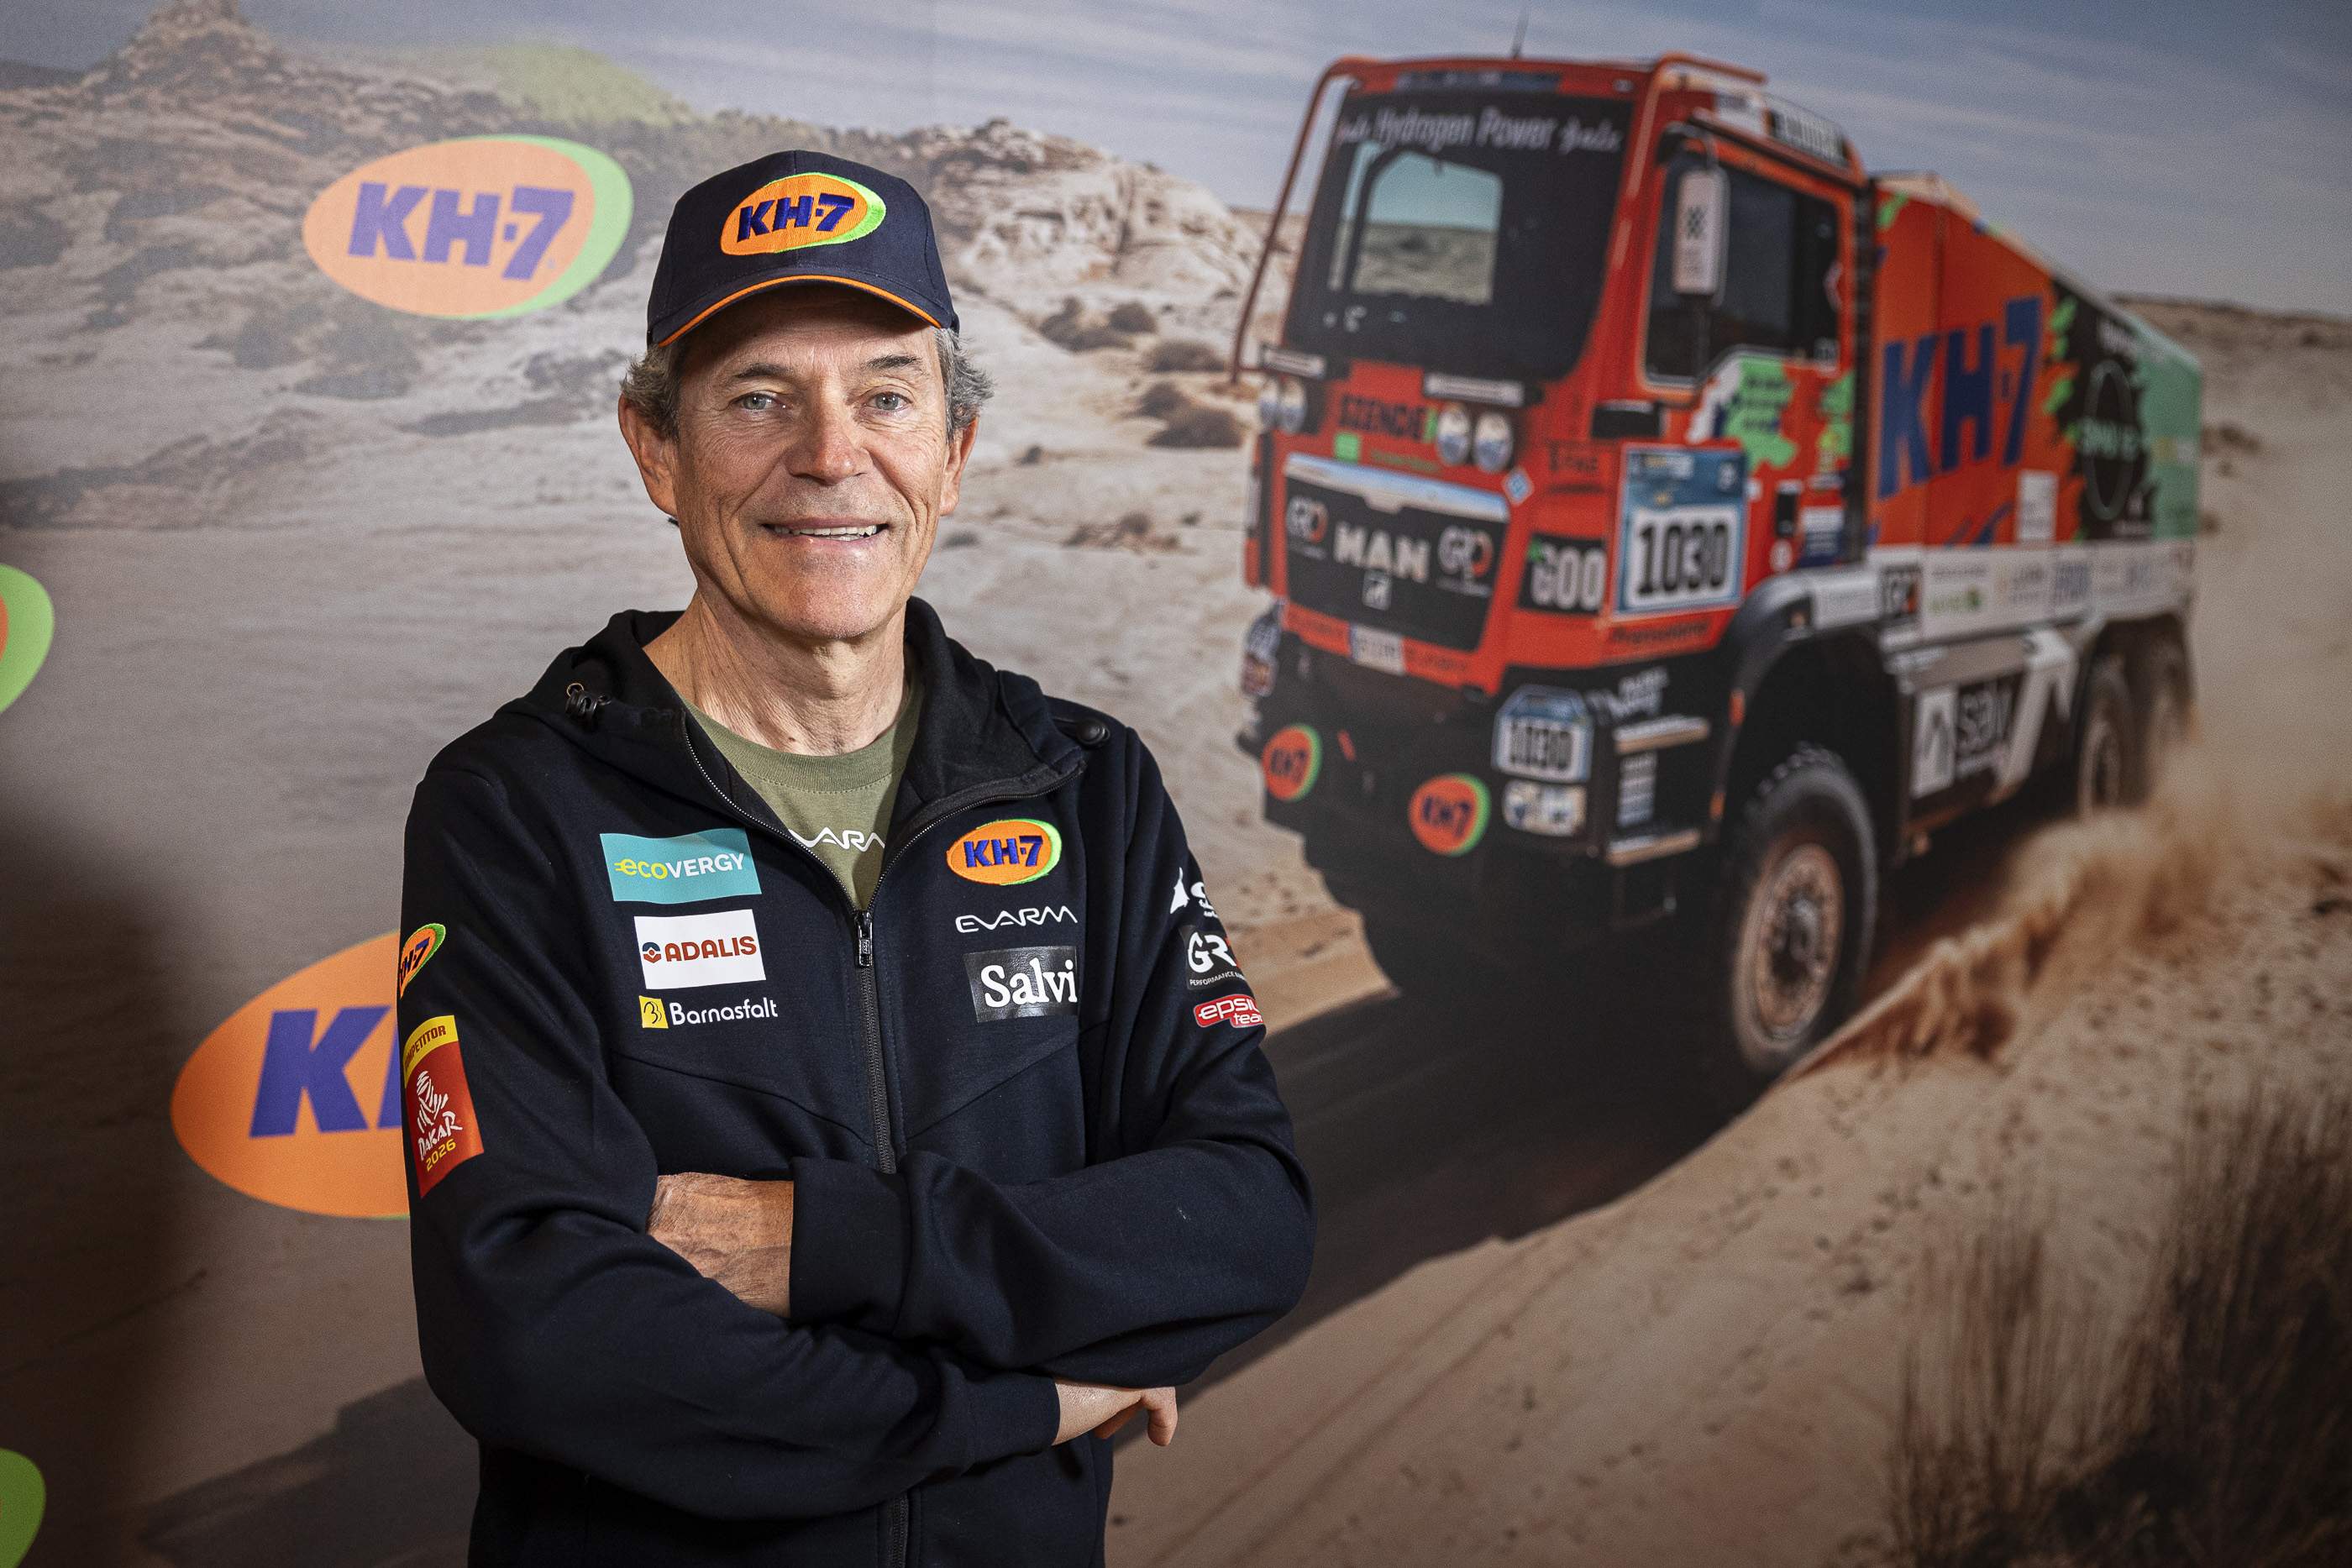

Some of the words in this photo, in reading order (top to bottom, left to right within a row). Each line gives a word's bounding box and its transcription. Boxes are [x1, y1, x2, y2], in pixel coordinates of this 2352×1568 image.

[348, 181, 576, 282] KH-7
[737, 192, 855, 243] KH-7
[1333, 521, 1431, 584] MAN
[1638, 523, 1729, 596] 1030
[963, 835, 1044, 868] KH-7
[955, 905, 1078, 933] EVARM
[664, 936, 757, 962] ADALIS
[980, 957, 1078, 1008] Salvi
[1189, 971, 1236, 986] PERFORMANCE
[669, 997, 779, 1025] Barnasfalt
[249, 1005, 402, 1140] K
[418, 1110, 463, 1162] DAKAR
[425, 1139, 456, 1172] 2026
